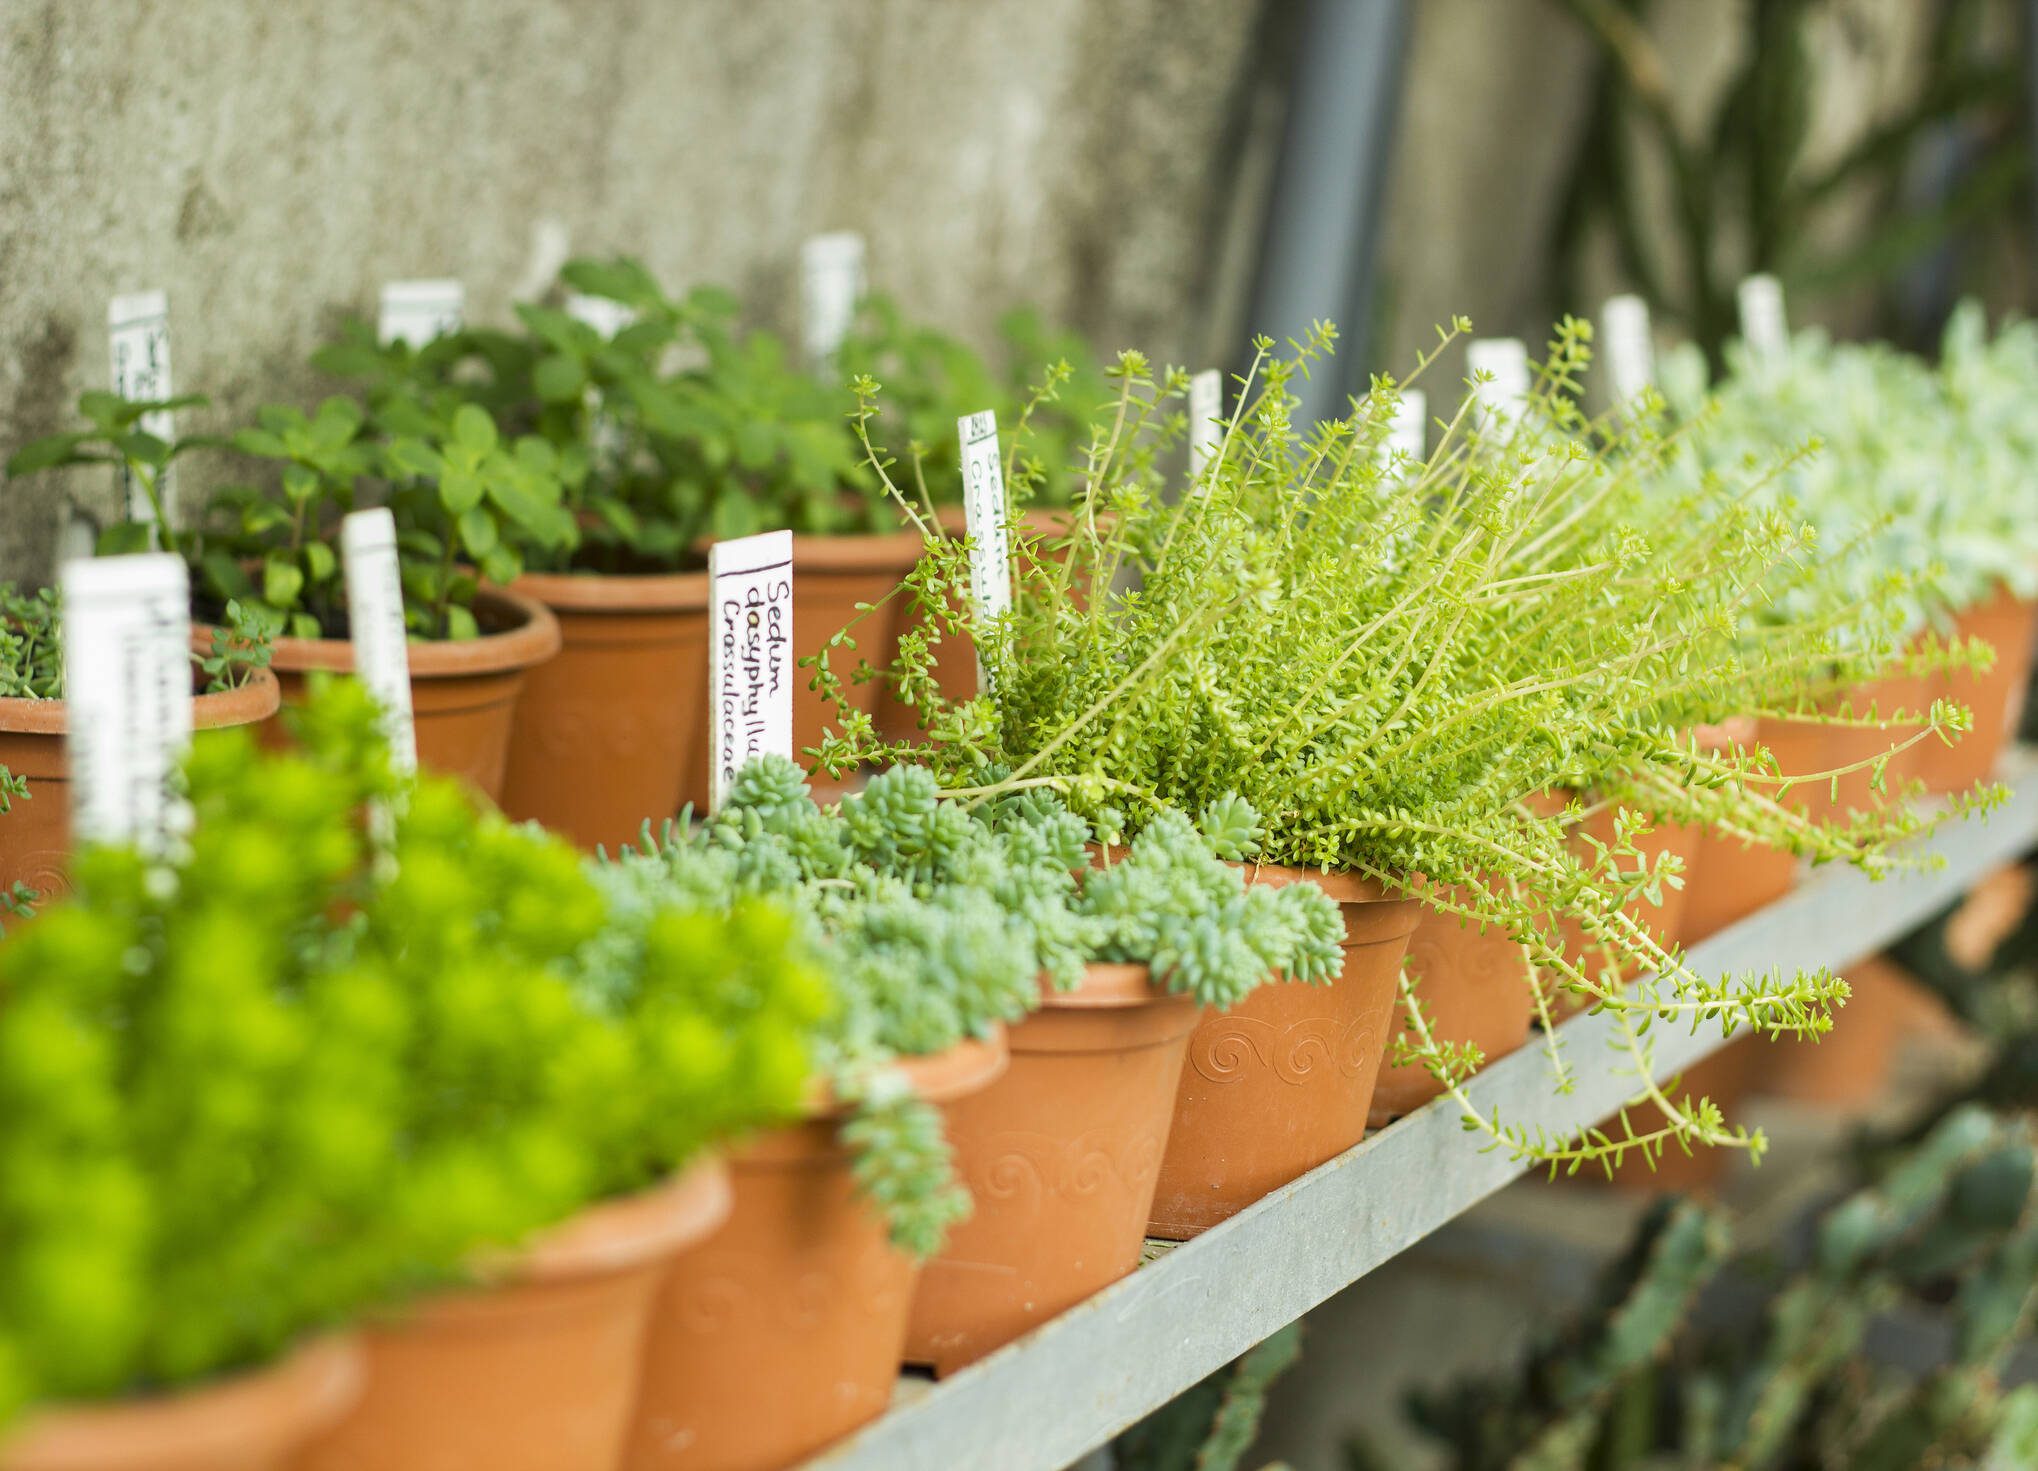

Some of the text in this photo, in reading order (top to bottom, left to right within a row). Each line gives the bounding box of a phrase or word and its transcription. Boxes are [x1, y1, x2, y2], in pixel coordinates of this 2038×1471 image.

[987, 452, 1004, 579] Sedum
[722, 600, 741, 782] Crassulaceae
[741, 586, 766, 758] dasyphyllu
[766, 580, 790, 698] Sedum
